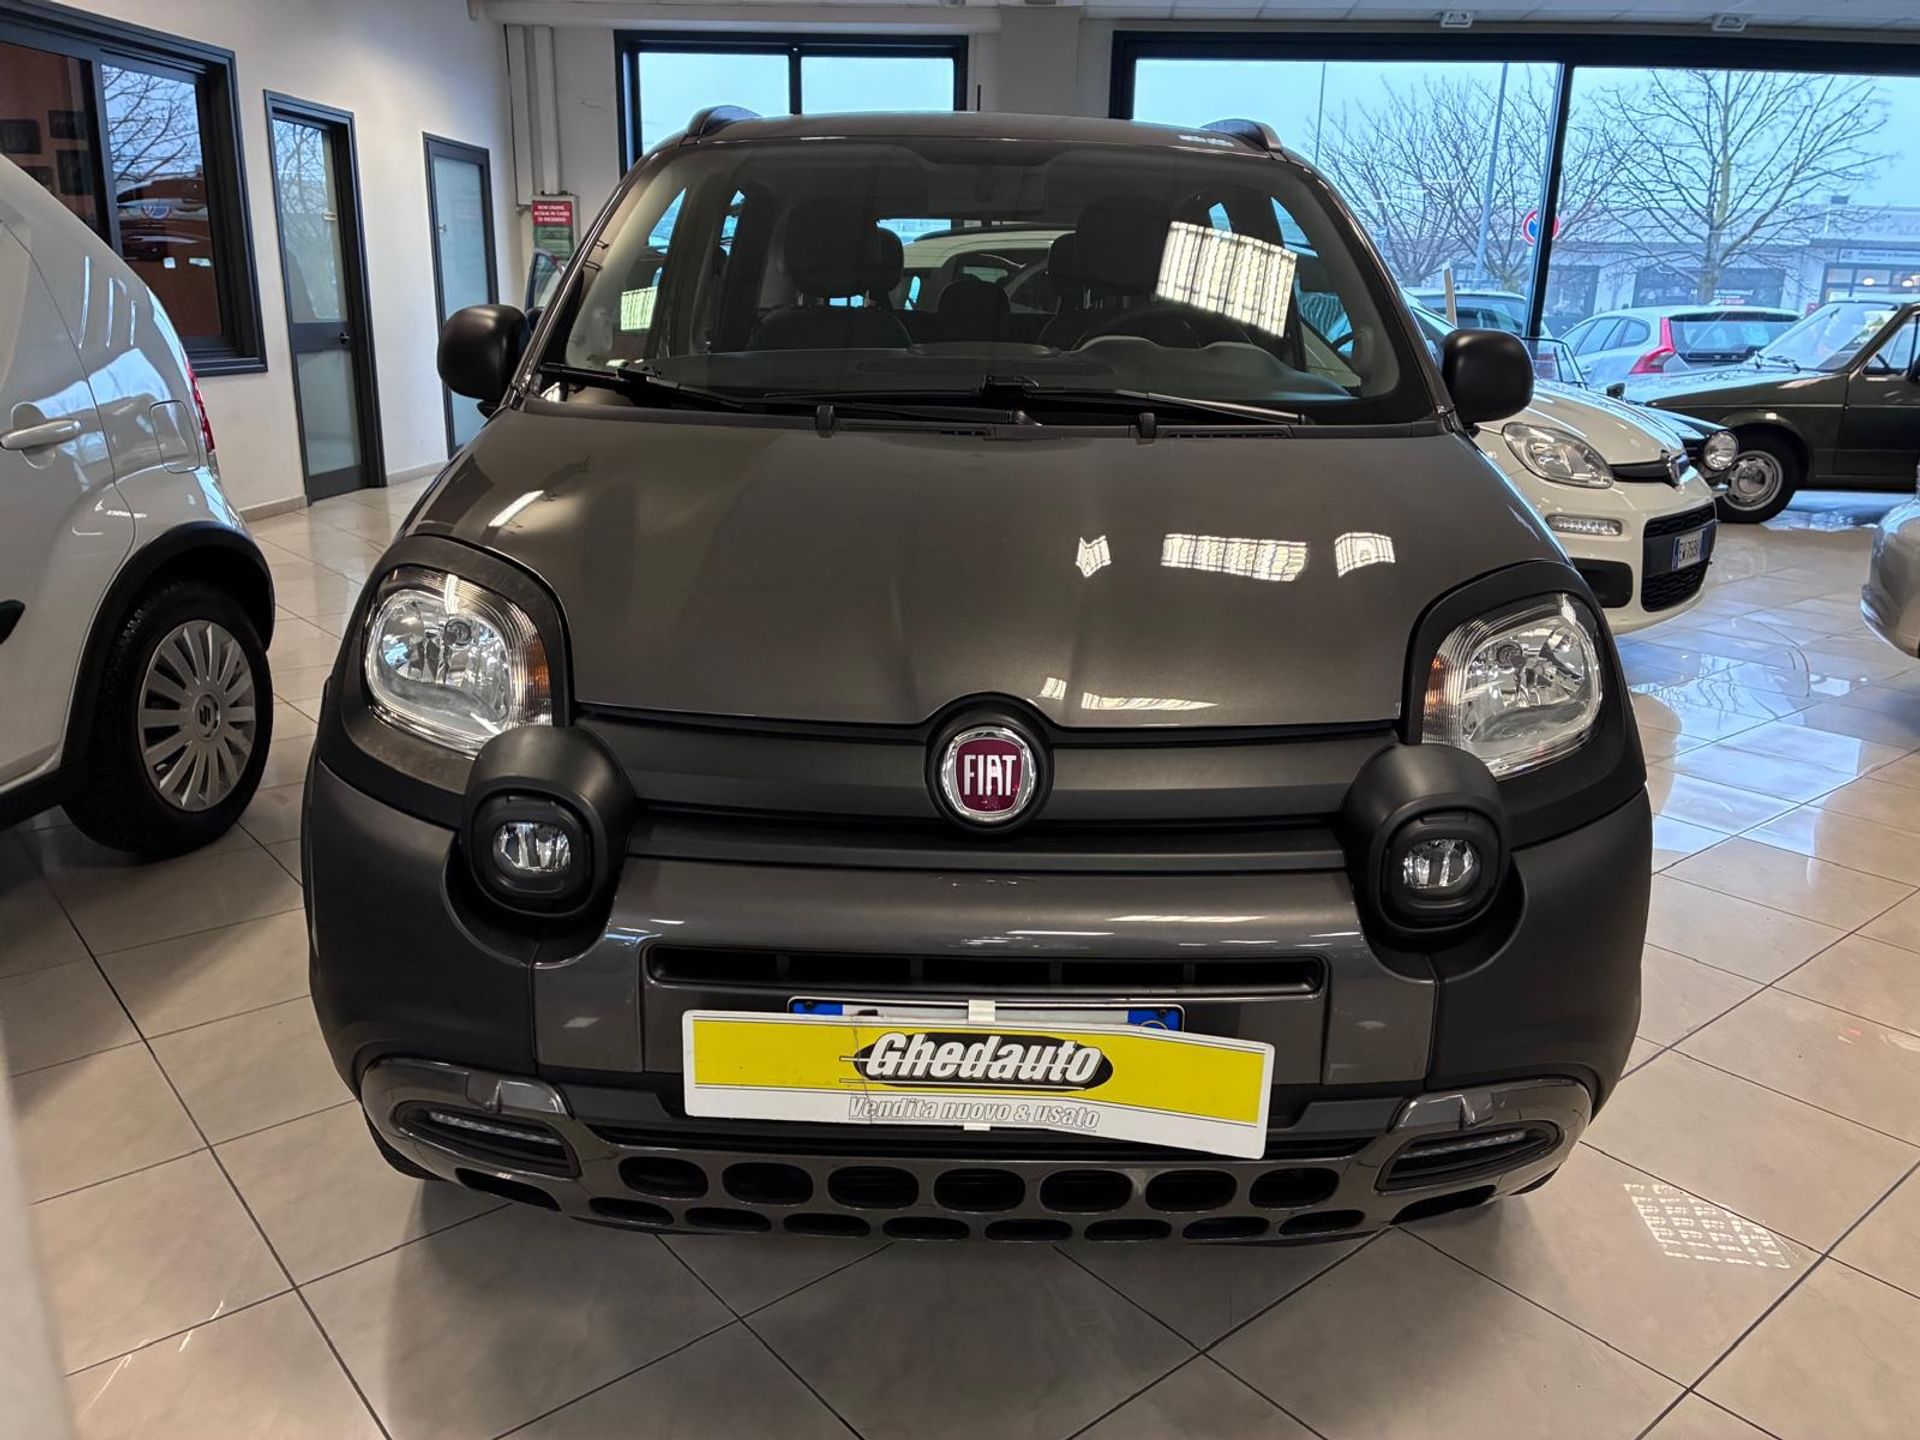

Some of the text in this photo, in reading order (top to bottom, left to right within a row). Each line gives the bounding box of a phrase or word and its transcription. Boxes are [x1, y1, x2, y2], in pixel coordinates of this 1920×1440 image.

[963, 754, 1017, 796] FIAT
[865, 1032, 1104, 1084] Ghedauto
[849, 1096, 1101, 1130] Vendita nuovo & usato
